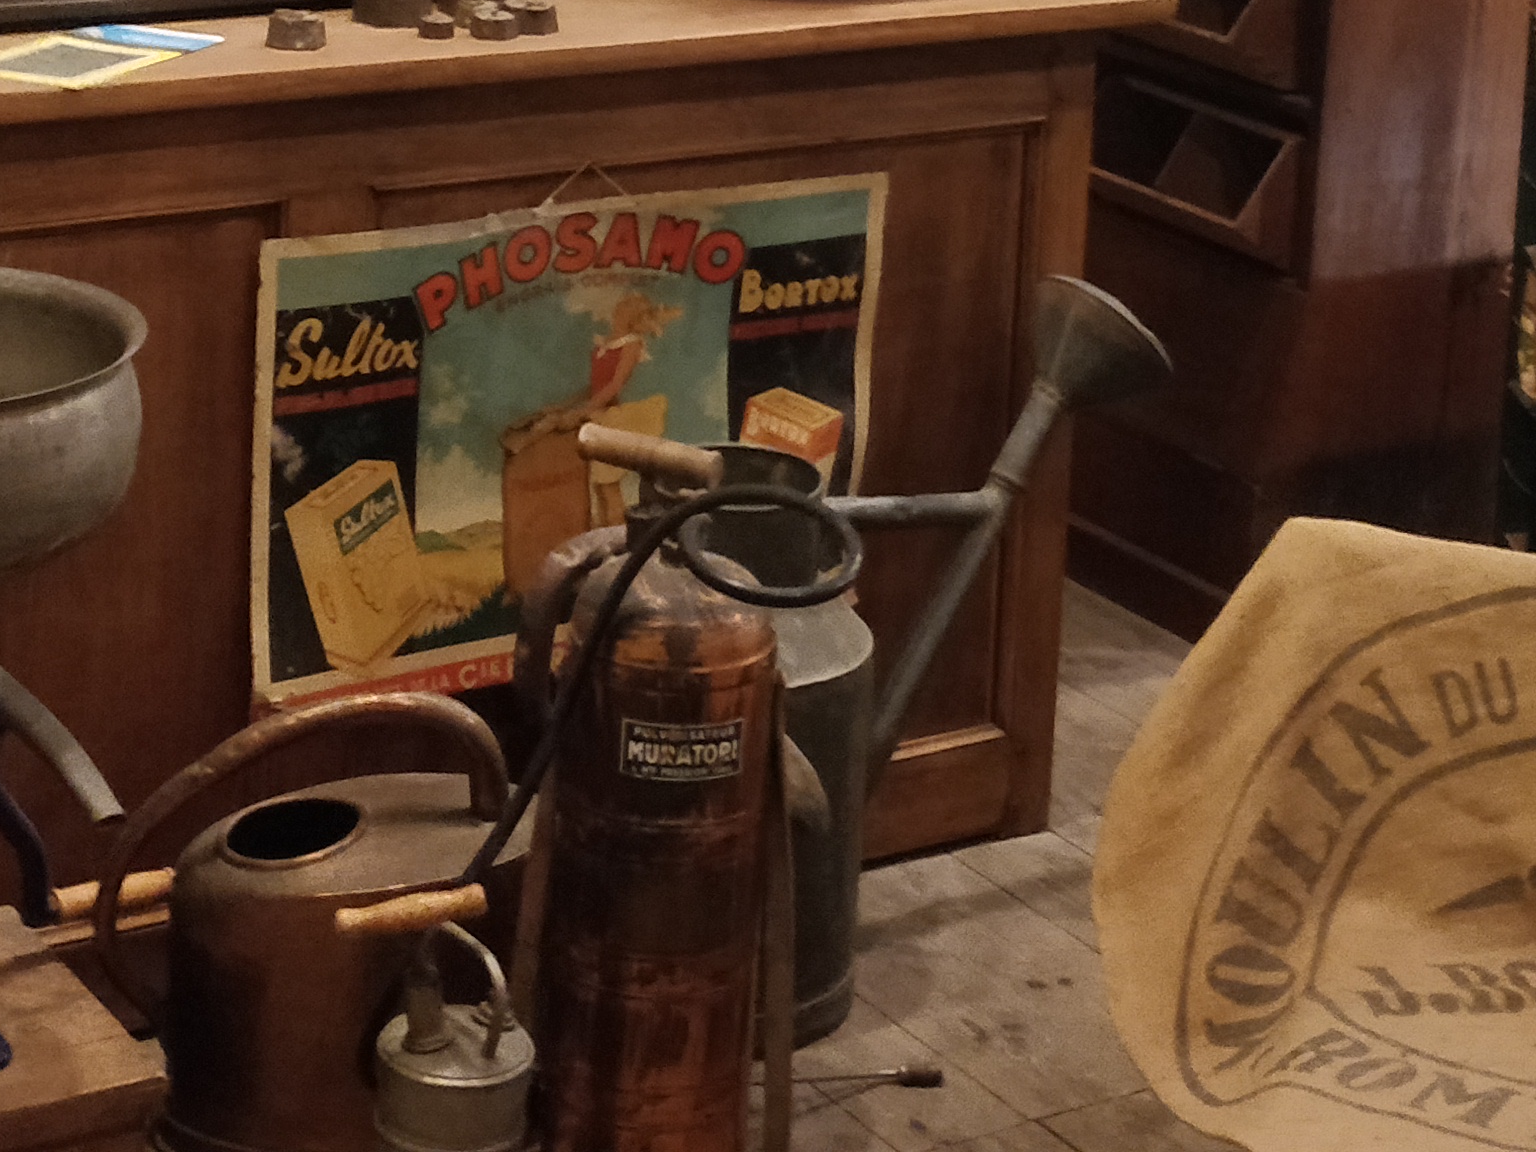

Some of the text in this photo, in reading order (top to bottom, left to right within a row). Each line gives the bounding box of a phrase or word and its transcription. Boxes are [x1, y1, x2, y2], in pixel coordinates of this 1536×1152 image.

[413, 211, 746, 331] PHOSAMO
[275, 315, 421, 389] Sultox
[626, 739, 739, 766] MURATORI
[1202, 668, 1431, 1074] MOULIN
[1430, 656, 1523, 738] DU
